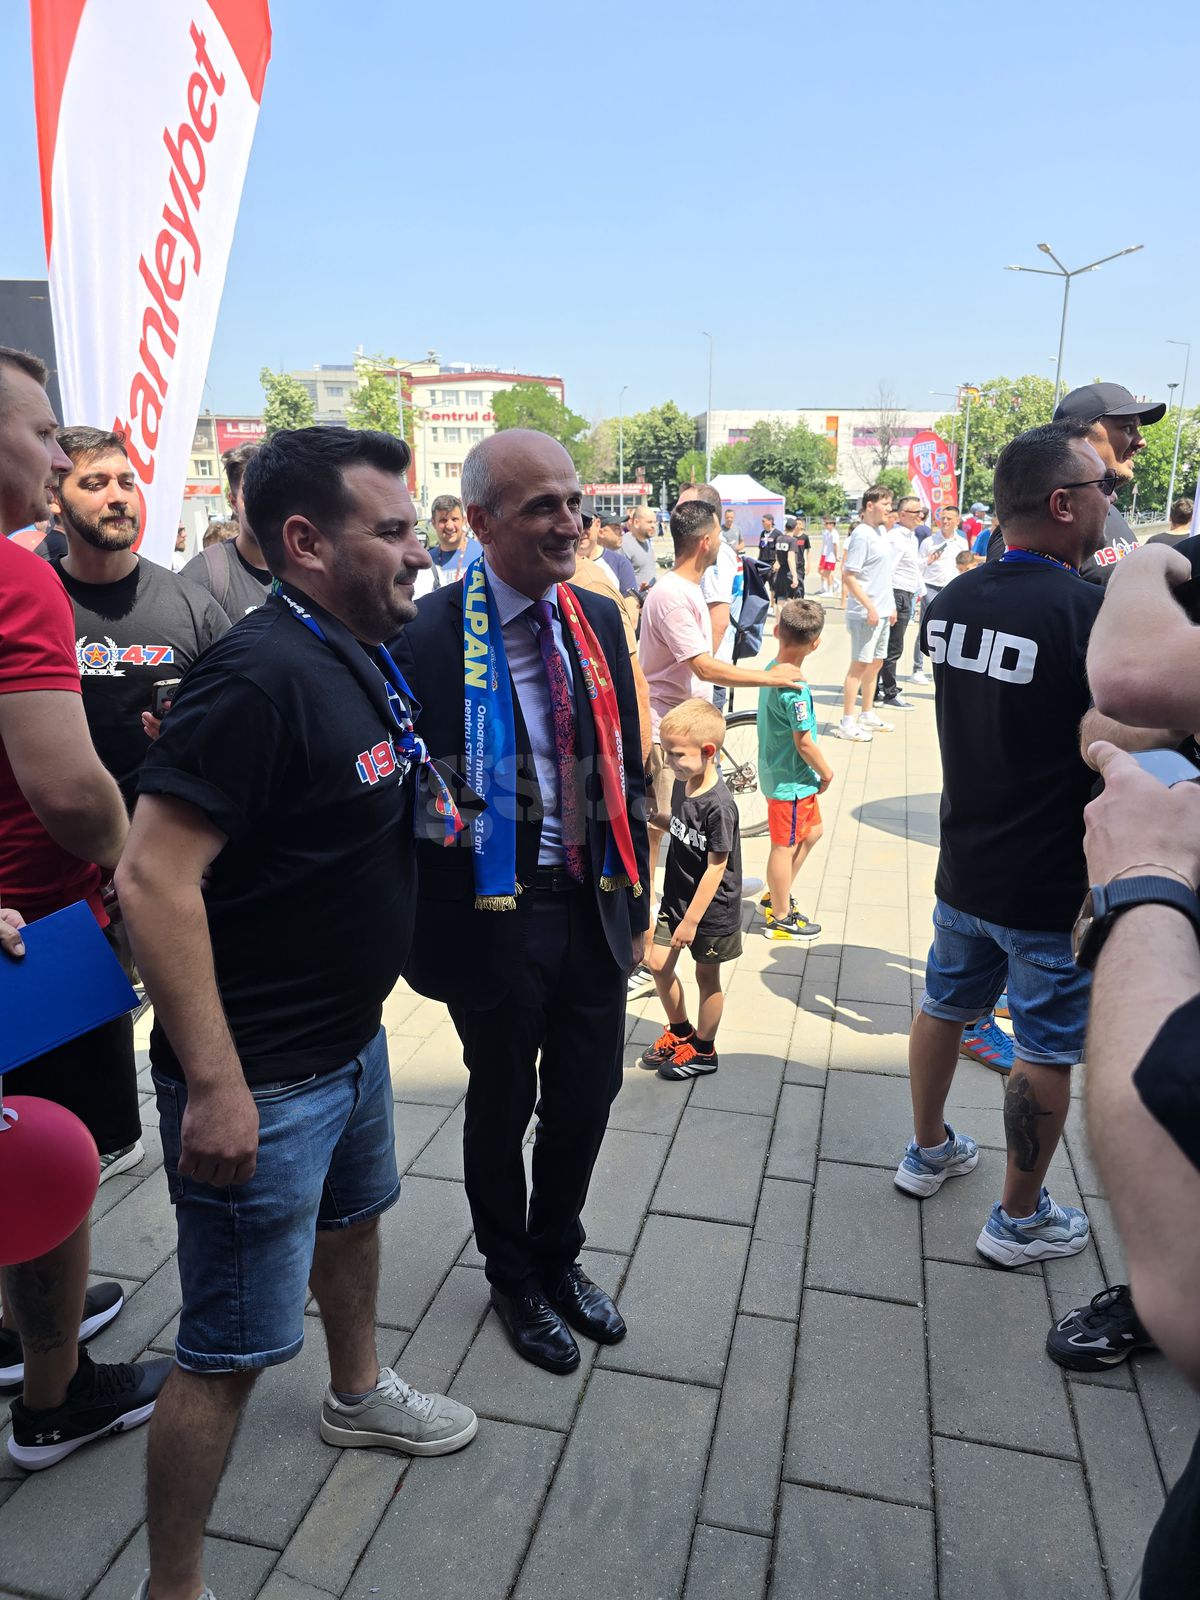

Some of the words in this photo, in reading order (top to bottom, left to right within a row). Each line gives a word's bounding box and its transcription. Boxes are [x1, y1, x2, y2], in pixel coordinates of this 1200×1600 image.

[121, 644, 173, 667] 47
[926, 619, 1039, 685] SUD
[464, 699, 473, 738] pentru
[477, 705, 487, 755] Onoarea
[357, 740, 396, 786] 19
[474, 836, 485, 855] ani
[475, 819, 485, 833] 23
